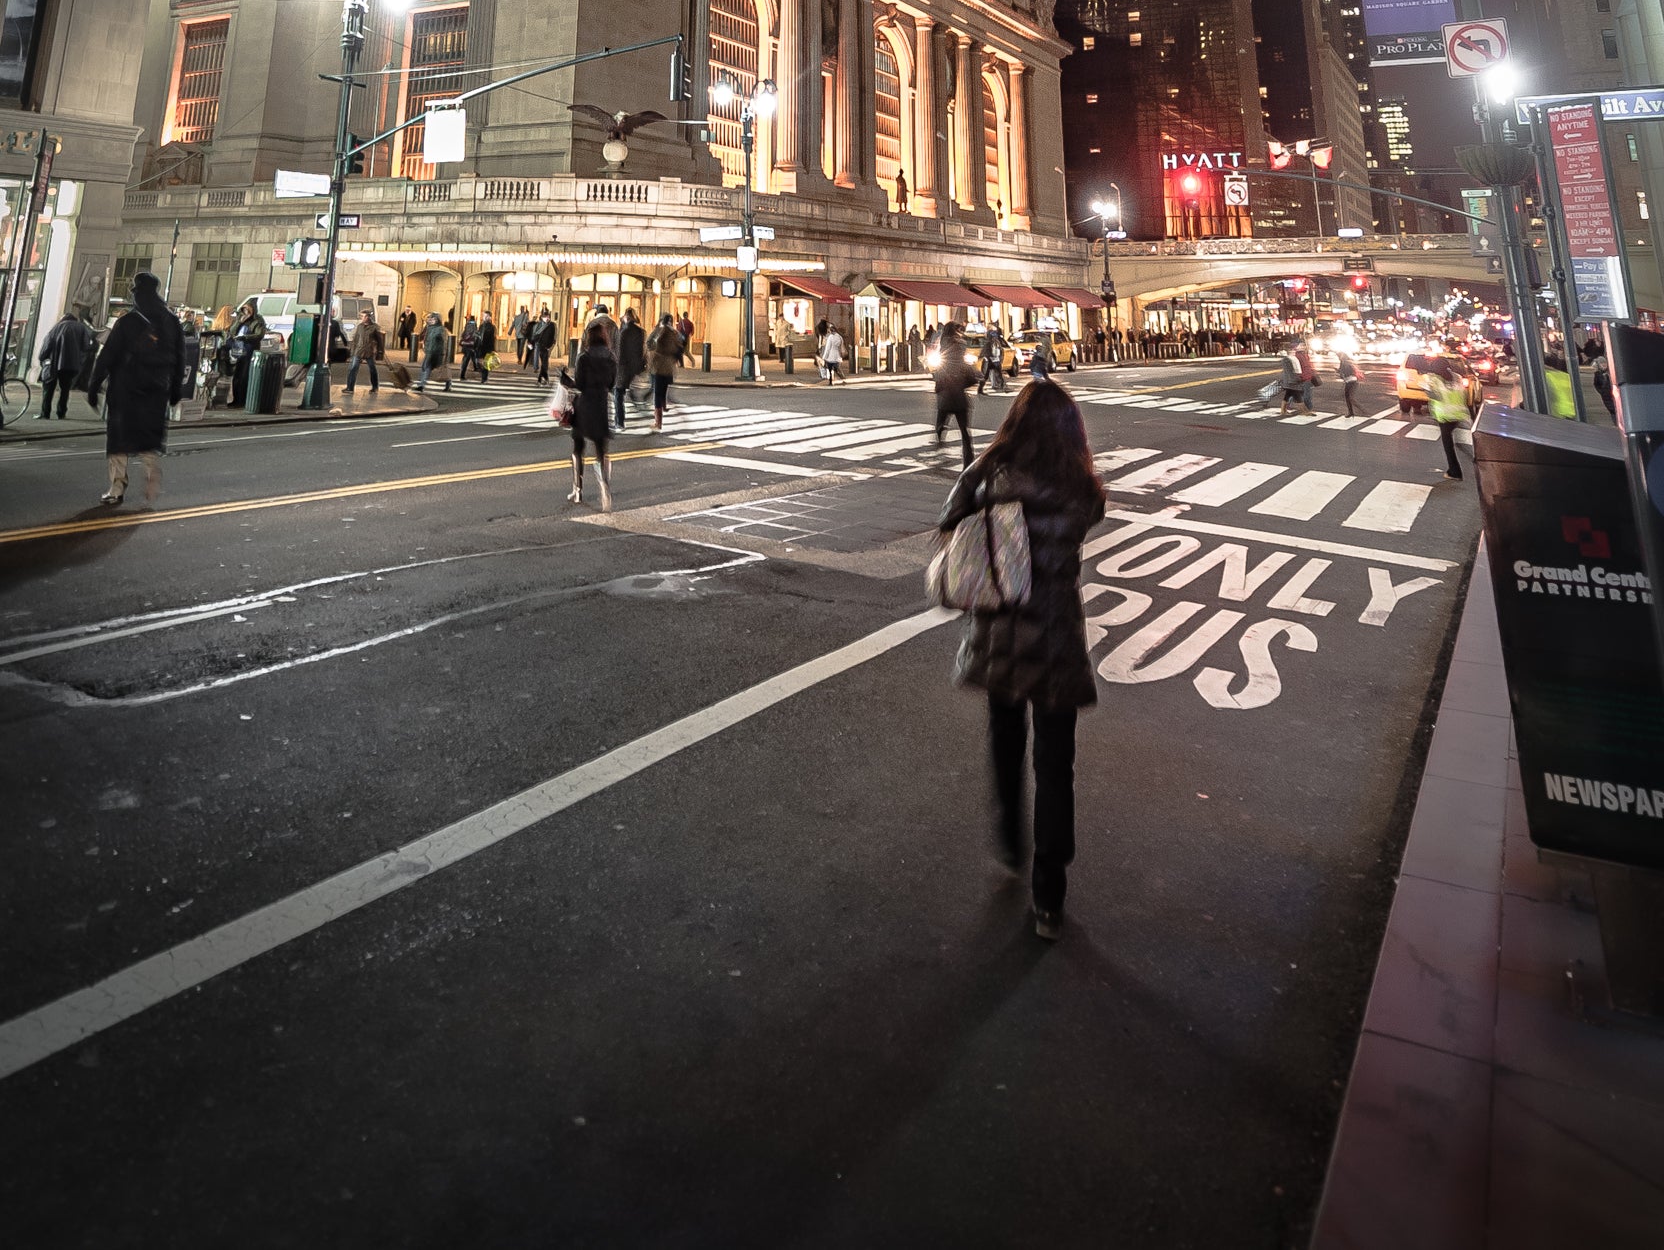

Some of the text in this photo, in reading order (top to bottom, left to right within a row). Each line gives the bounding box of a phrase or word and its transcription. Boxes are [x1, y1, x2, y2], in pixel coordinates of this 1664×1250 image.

[1396, 0, 1420, 8] SQUARE
[1376, 45, 1405, 55] PRO
[1633, 96, 1664, 114] Av
[1549, 109, 1593, 123] NO STANDING
[1557, 120, 1590, 131] ANYTIME
[1556, 145, 1598, 157] NO STANDING
[1163, 152, 1241, 170] HYATT
[1562, 184, 1605, 195] NO STANDING
[1513, 560, 1588, 583] Grand
[1096, 534, 1444, 626] ONLY
